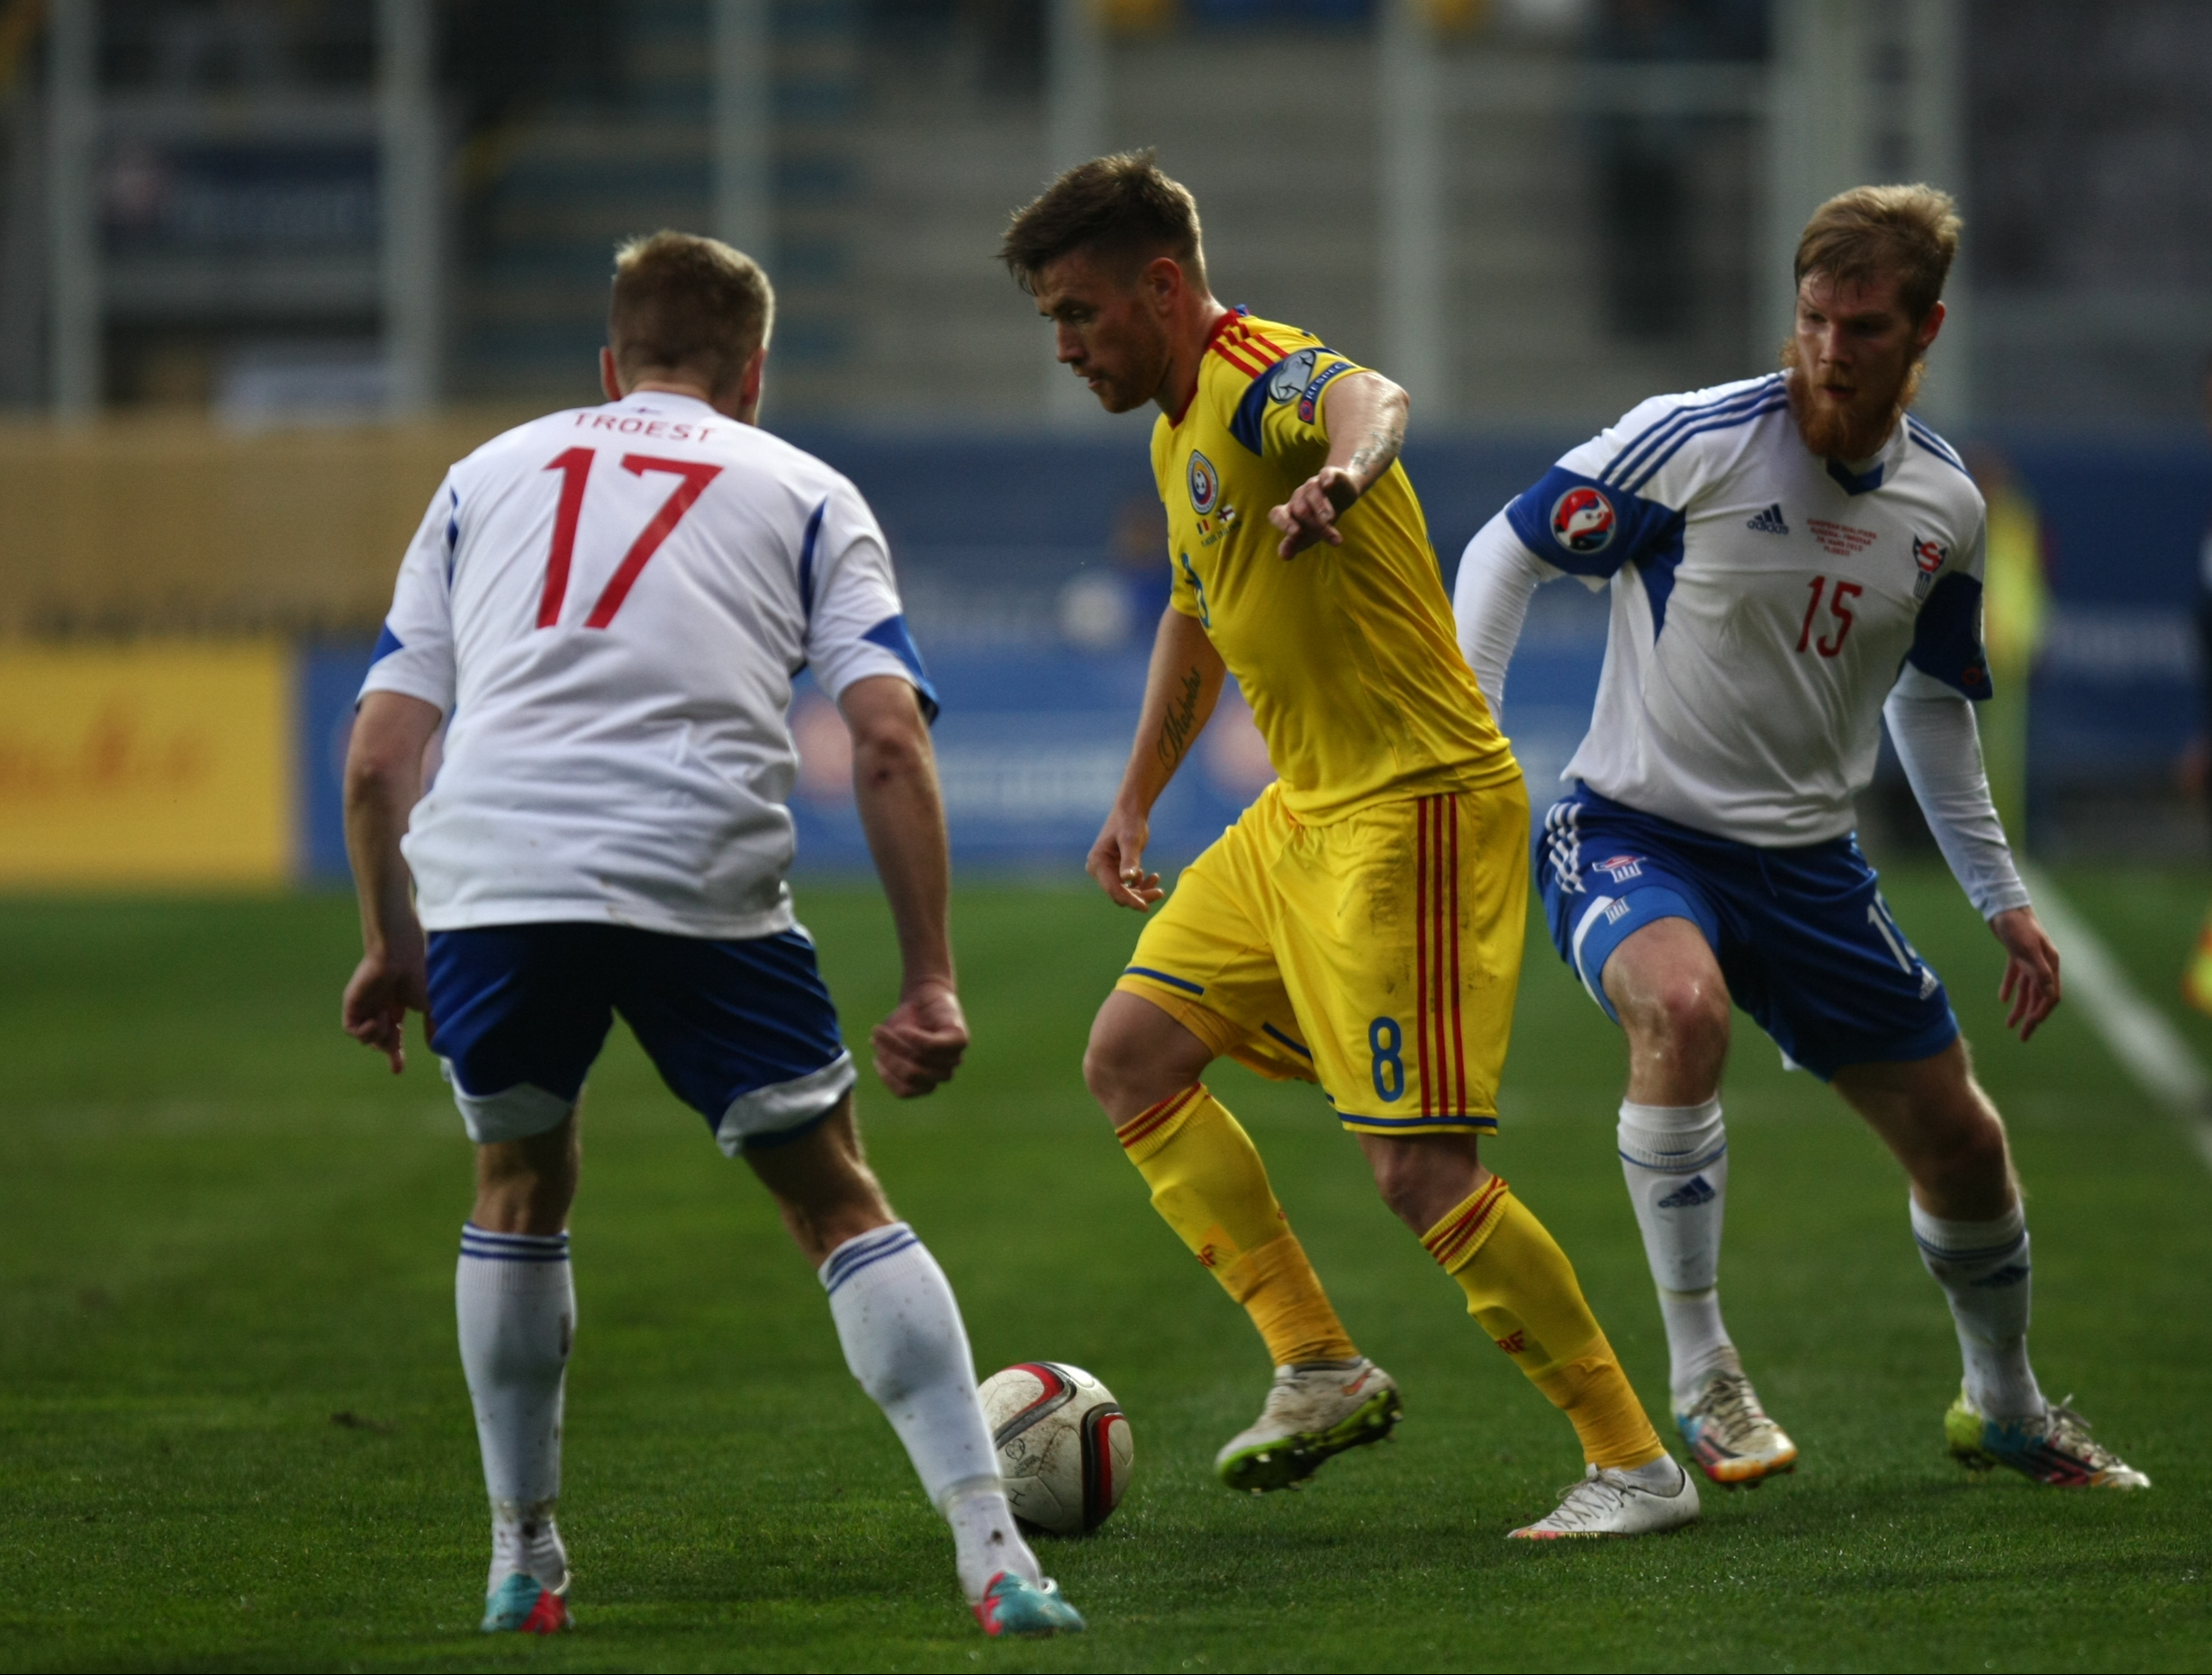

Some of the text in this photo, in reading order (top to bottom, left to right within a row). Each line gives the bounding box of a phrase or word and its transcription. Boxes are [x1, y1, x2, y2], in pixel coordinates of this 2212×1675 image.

[573, 412, 718, 442] TROEST
[536, 445, 724, 630] 17
[1747, 520, 1789, 535] adidas
[1796, 575, 1864, 658] 15
[1368, 1016, 1404, 1103] 8
